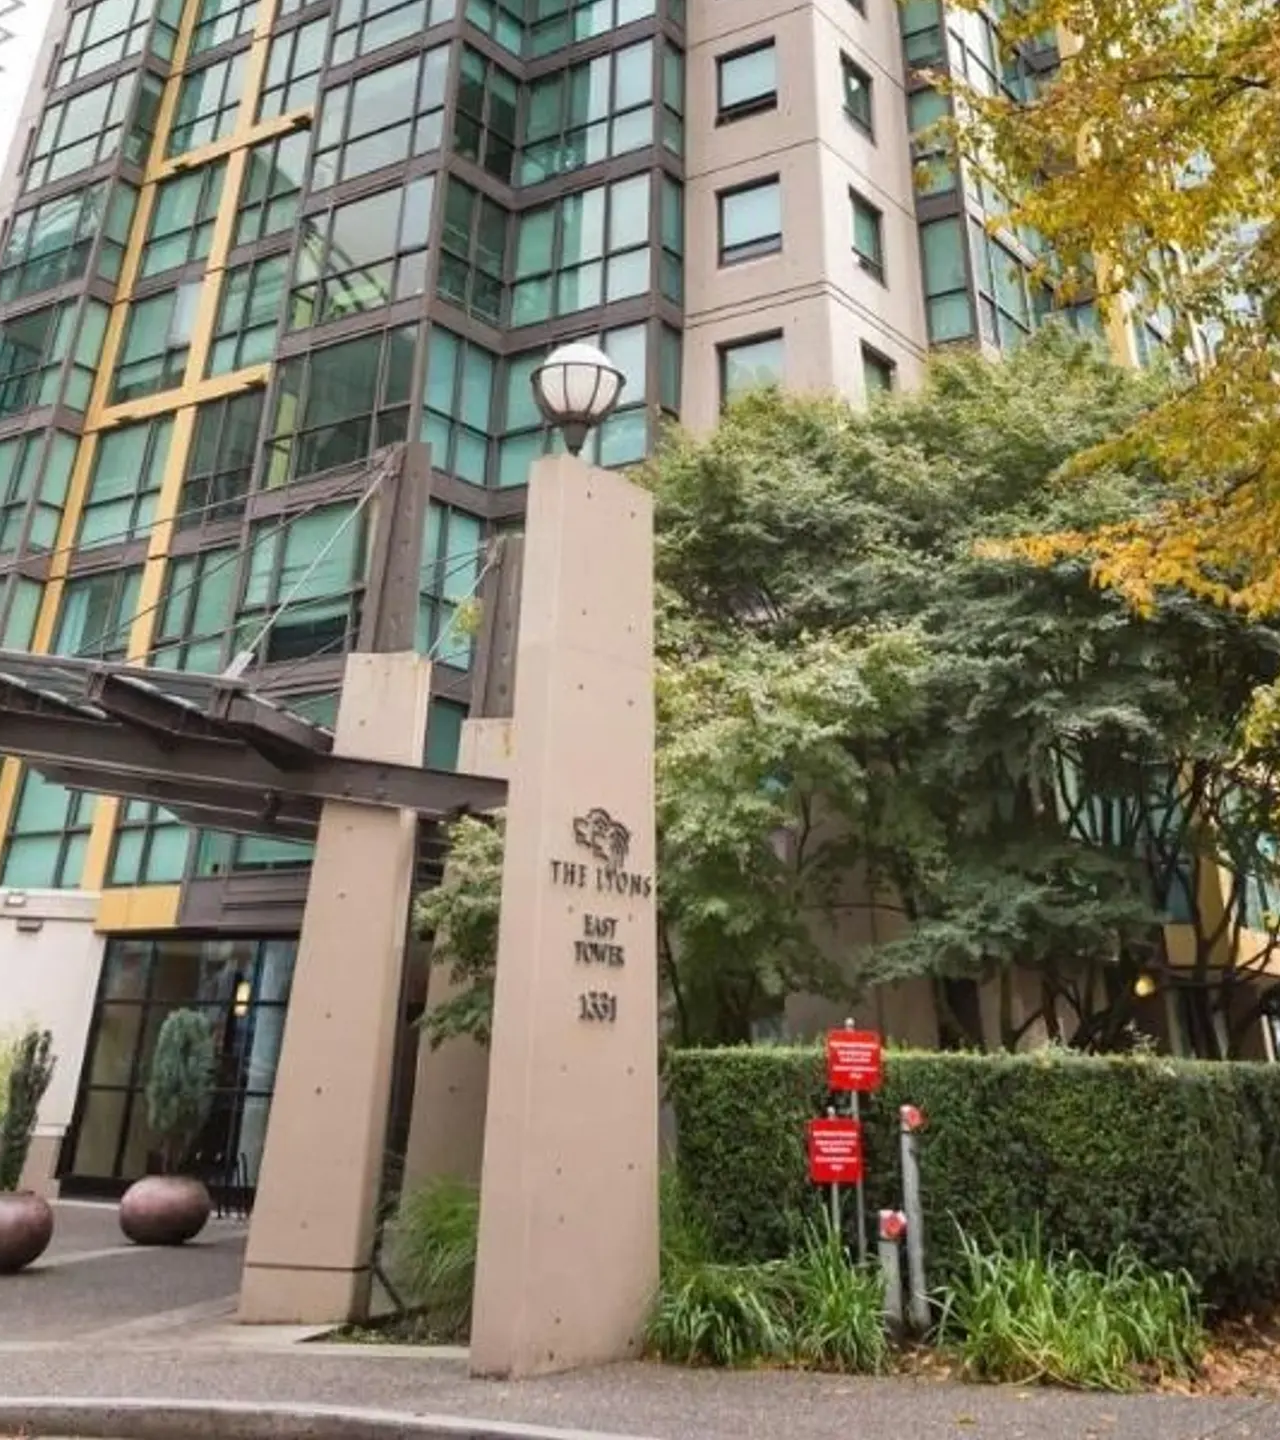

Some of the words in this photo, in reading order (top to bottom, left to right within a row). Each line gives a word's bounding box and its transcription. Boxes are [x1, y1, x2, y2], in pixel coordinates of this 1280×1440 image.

[549, 860, 587, 889] THE
[596, 867, 652, 898] LYONS
[583, 913, 618, 939] EAST
[574, 940, 625, 969] TOWER
